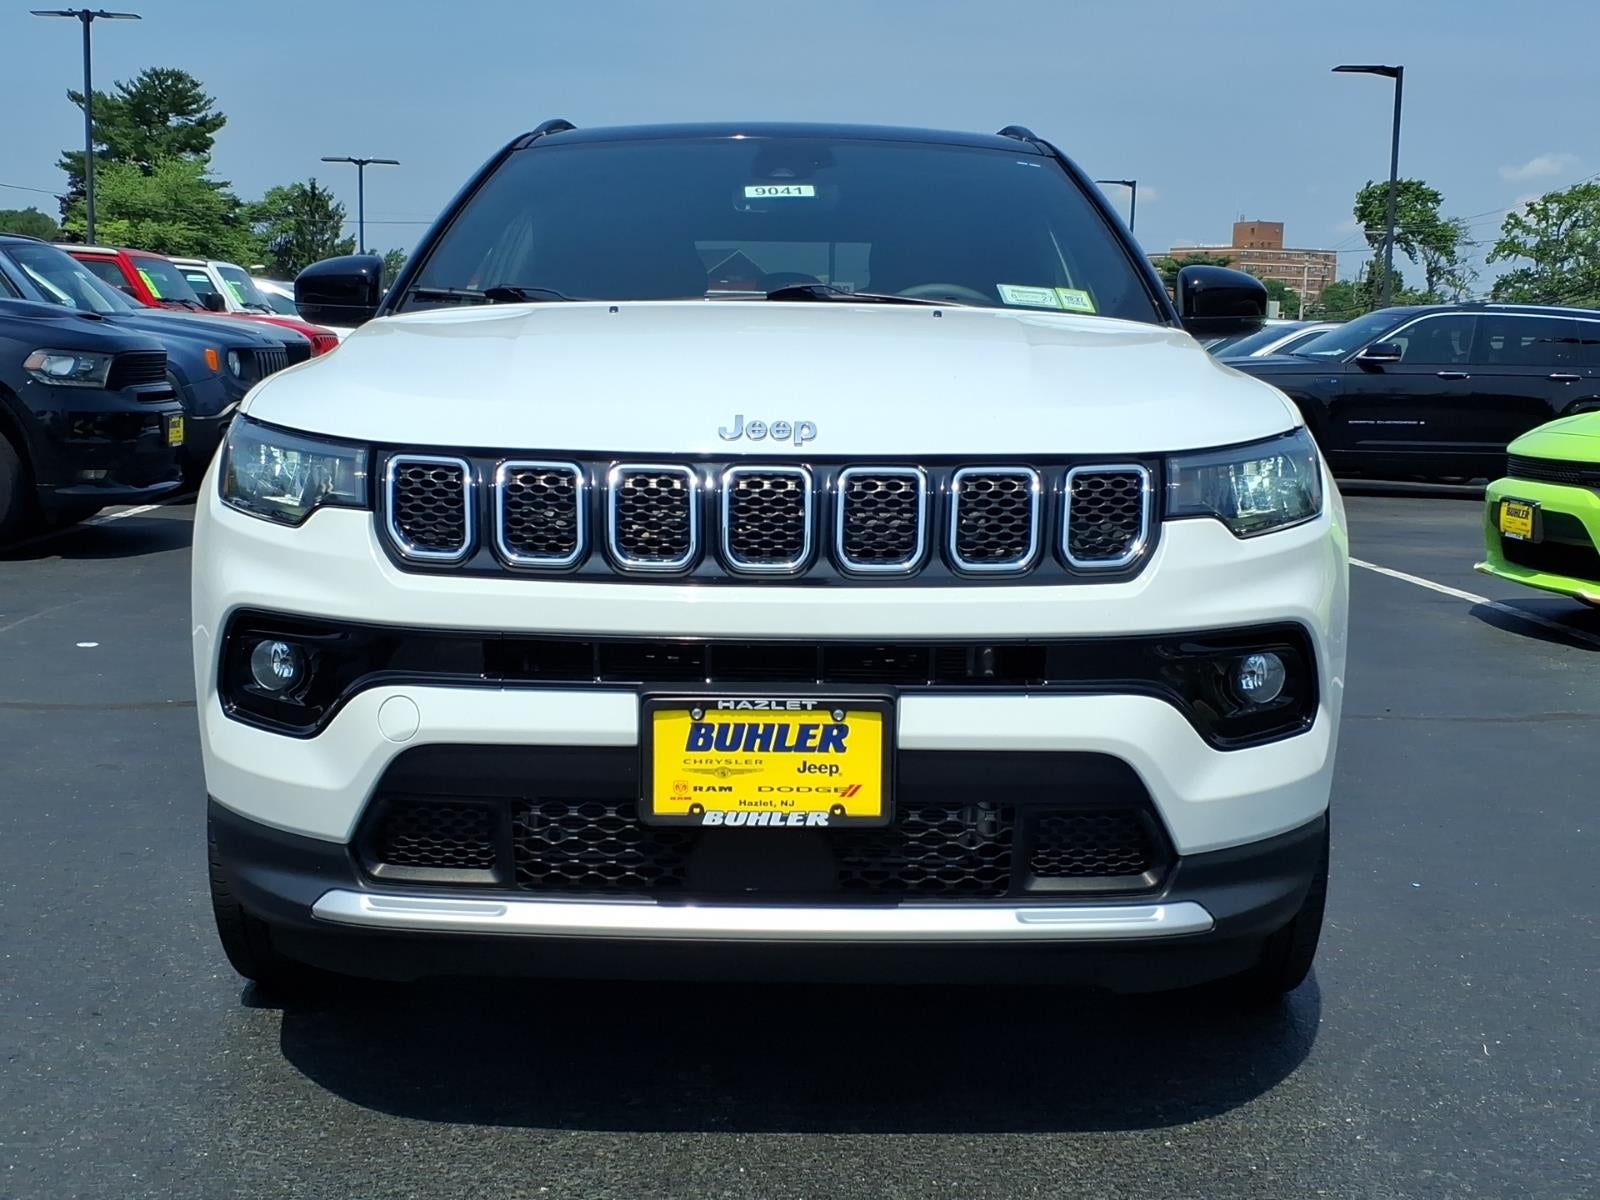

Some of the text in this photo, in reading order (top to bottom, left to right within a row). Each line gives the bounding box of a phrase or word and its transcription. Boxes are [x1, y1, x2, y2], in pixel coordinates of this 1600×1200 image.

[755, 187, 802, 196] 9041
[718, 414, 817, 447] Jeep
[717, 700, 818, 710] HAZLET
[685, 722, 849, 753] BUHLER
[797, 760, 840, 777] Jeep
[702, 811, 829, 826] BUHLER
